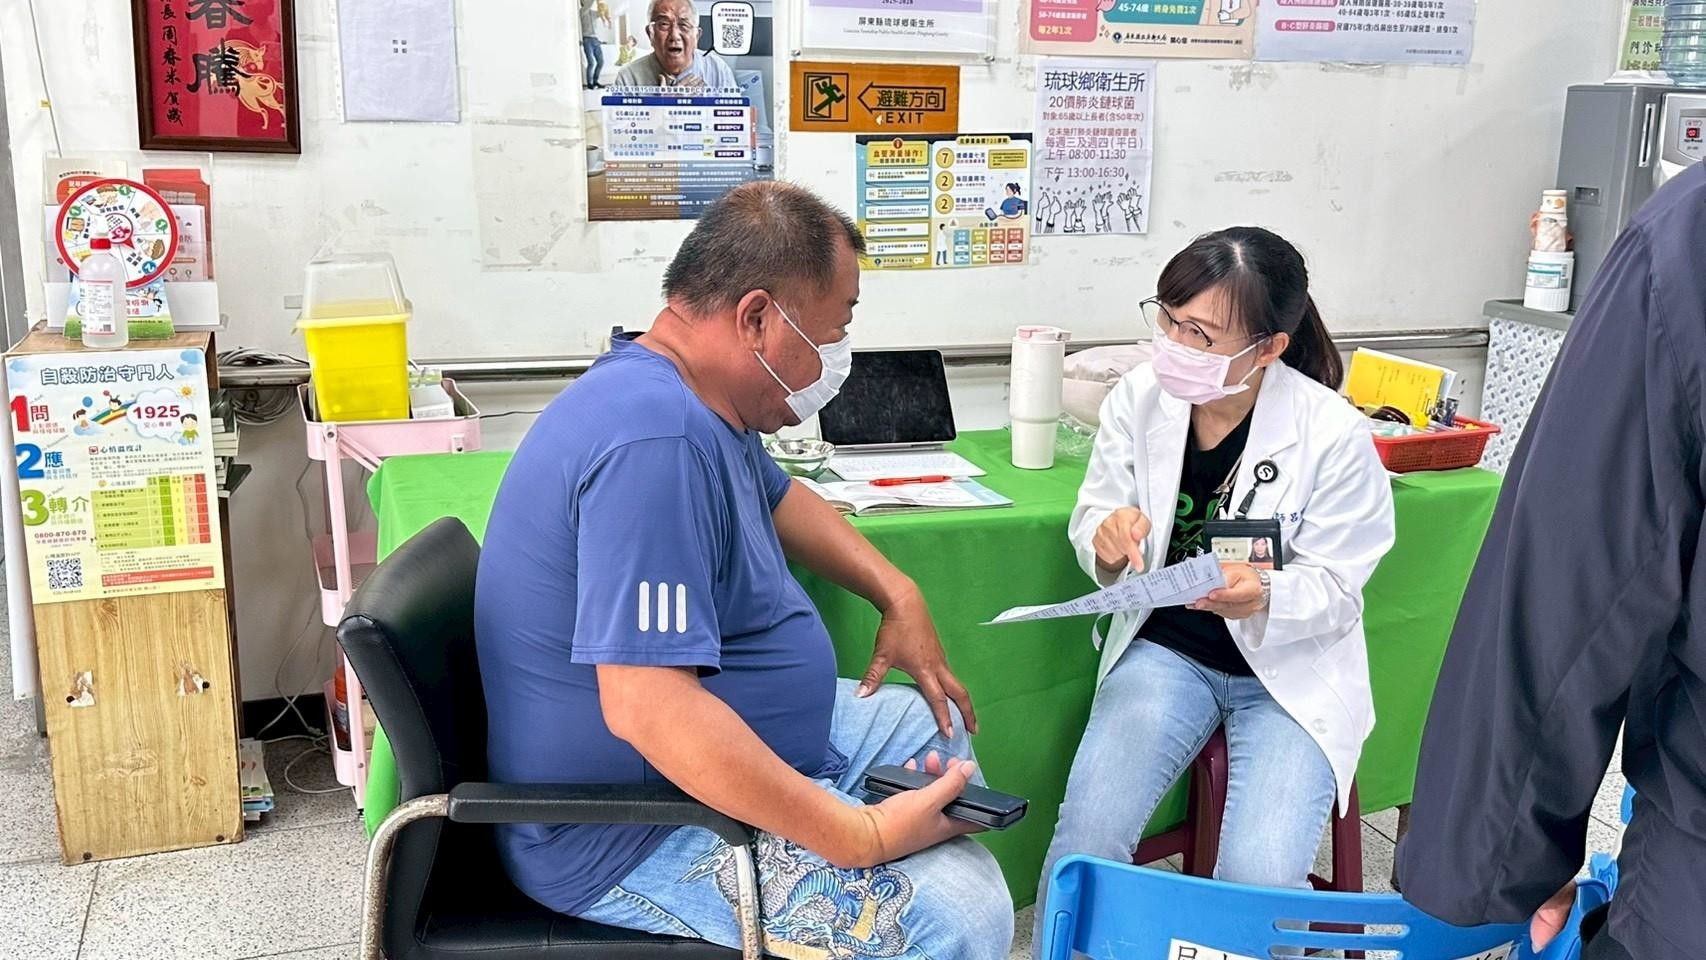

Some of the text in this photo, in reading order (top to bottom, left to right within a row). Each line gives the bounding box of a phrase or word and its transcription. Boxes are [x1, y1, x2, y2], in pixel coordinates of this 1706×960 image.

[858, 17, 935, 28] 屏東縣琉球鄉衛生所
[161, 0, 183, 126] 長周春米賀歲
[1045, 71, 1146, 92] 琉球鄉衛生所
[877, 90, 940, 108] 避難方向
[1049, 96, 1135, 110] 20價肺炎鏈球菌
[886, 112, 924, 124] EXIT
[942, 153, 949, 163] 7
[1045, 149, 1126, 160] 上午 08:00-11:30
[1044, 167, 1125, 178] 下午 13:00-16:30
[941, 176, 948, 187] 2
[941, 199, 948, 209] 2
[41, 364, 175, 385] 自殺防治守門人
[133, 405, 180, 419] 1925
